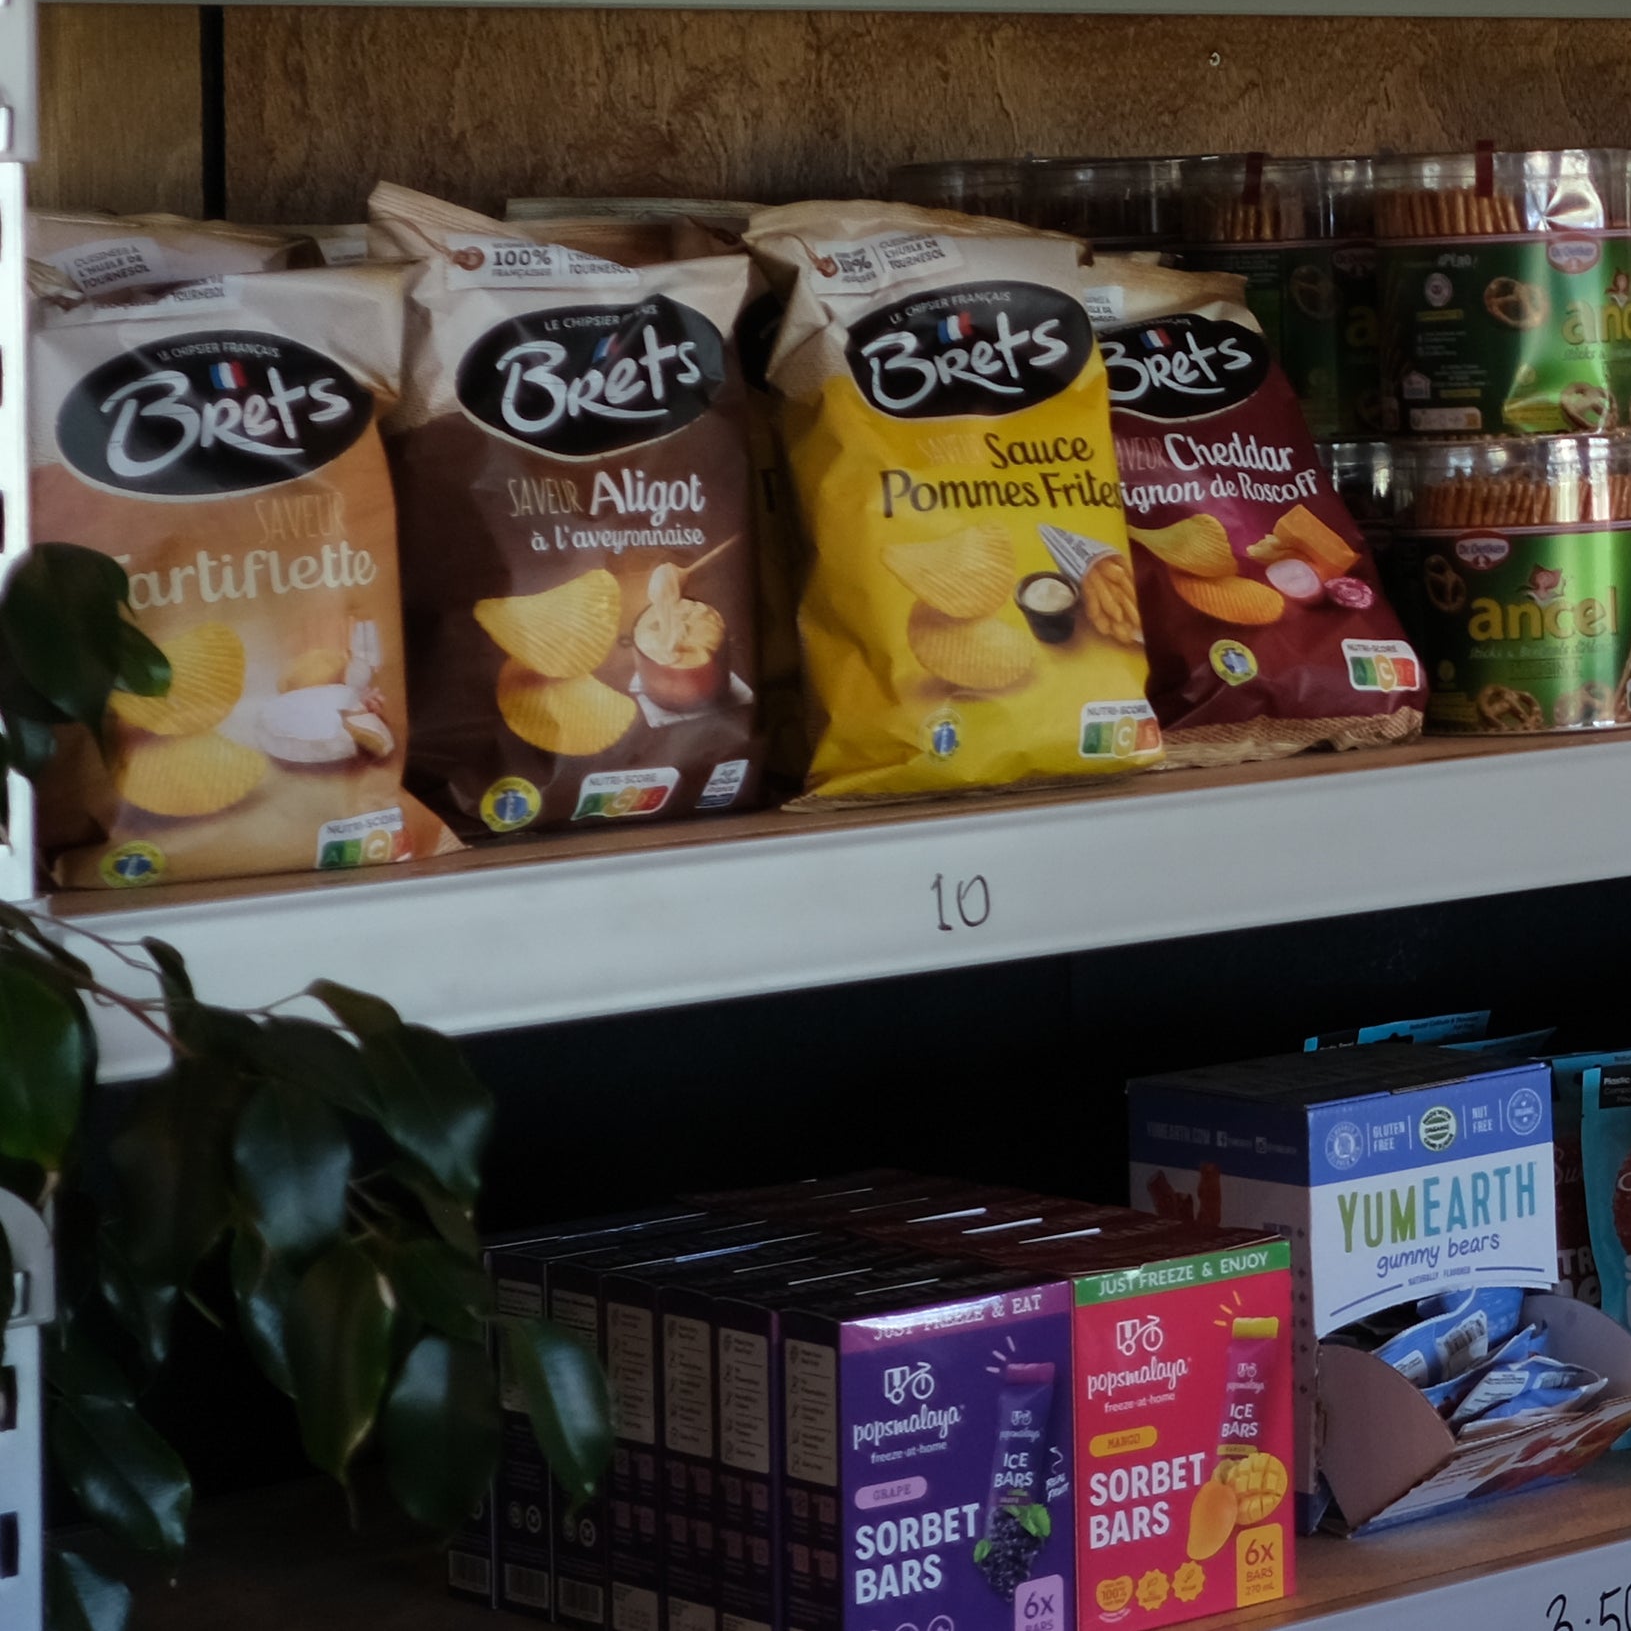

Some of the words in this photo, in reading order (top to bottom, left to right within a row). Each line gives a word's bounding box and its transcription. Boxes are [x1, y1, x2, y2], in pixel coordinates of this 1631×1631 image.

[496, 324, 700, 432] Brets
[861, 312, 1069, 409] Brets
[101, 368, 351, 477] Brets
[984, 432, 1094, 469] Sauce
[1164, 432, 1294, 472] Cheddar
[508, 478, 583, 517] SAVEUR
[589, 469, 705, 526] Aligot
[880, 469, 1040, 518] Pommes
[1210, 474, 1238, 498] de
[1239, 469, 1316, 503] Roscoff
[531, 531, 548, 551] à
[556, 525, 705, 554] l'aveyronnaise
[1468, 585, 1619, 641] ancel
[931, 872, 992, 931] 10
[1337, 1161, 1535, 1253] YUMEARTH
[1098, 1274, 1135, 1296] JUST
[1139, 1264, 1194, 1288] FREEZE
[1202, 1262, 1213, 1276] &
[1220, 1251, 1269, 1275] ENJOY
[1377, 1244, 1440, 1278] gummy
[1447, 1232, 1500, 1258] bears
[1087, 1356, 1188, 1400] popsmalaya
[1089, 1452, 1205, 1507] SORBET
[855, 1503, 980, 1560] SORBET
[1089, 1501, 1170, 1550] BARS
[855, 1554, 942, 1606] BARS
